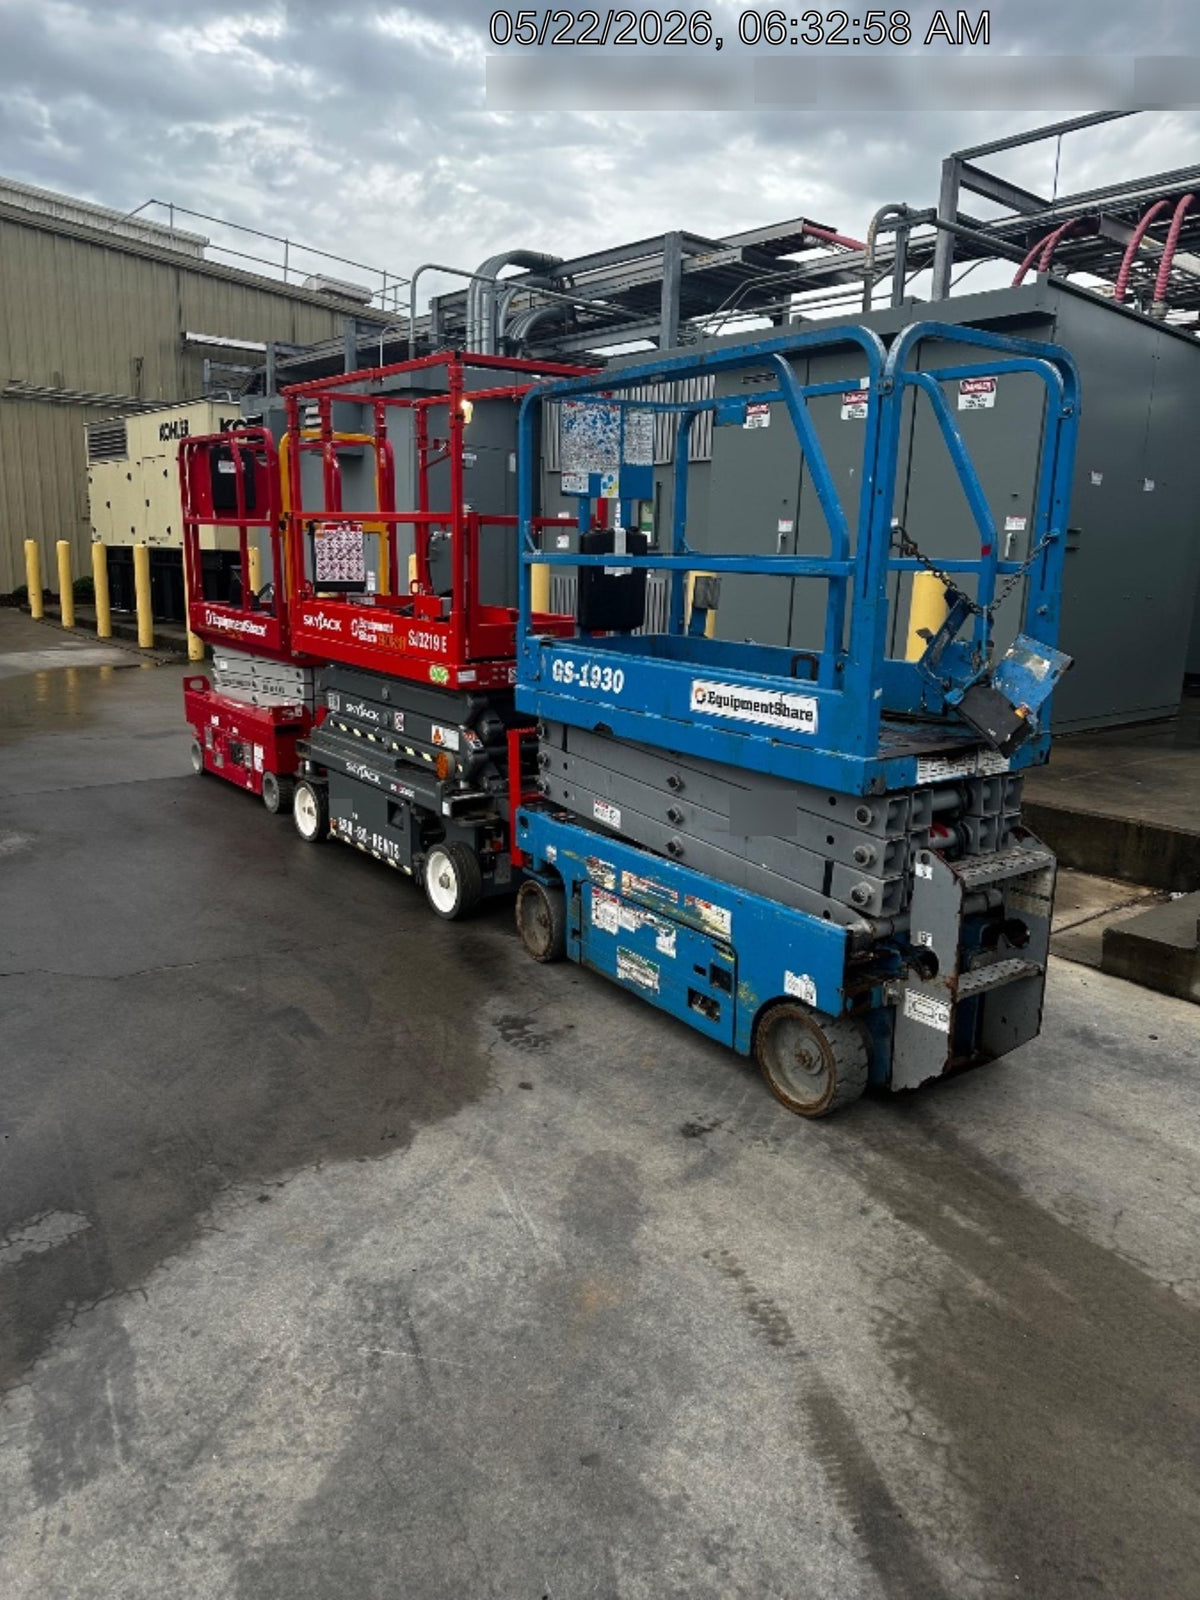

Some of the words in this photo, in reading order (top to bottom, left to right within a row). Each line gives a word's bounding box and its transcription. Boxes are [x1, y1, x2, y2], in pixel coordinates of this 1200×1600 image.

[303, 611, 342, 632] SKYJACK
[552, 658, 625, 694] GS-1930
[706, 691, 814, 722] EquipmentShare
